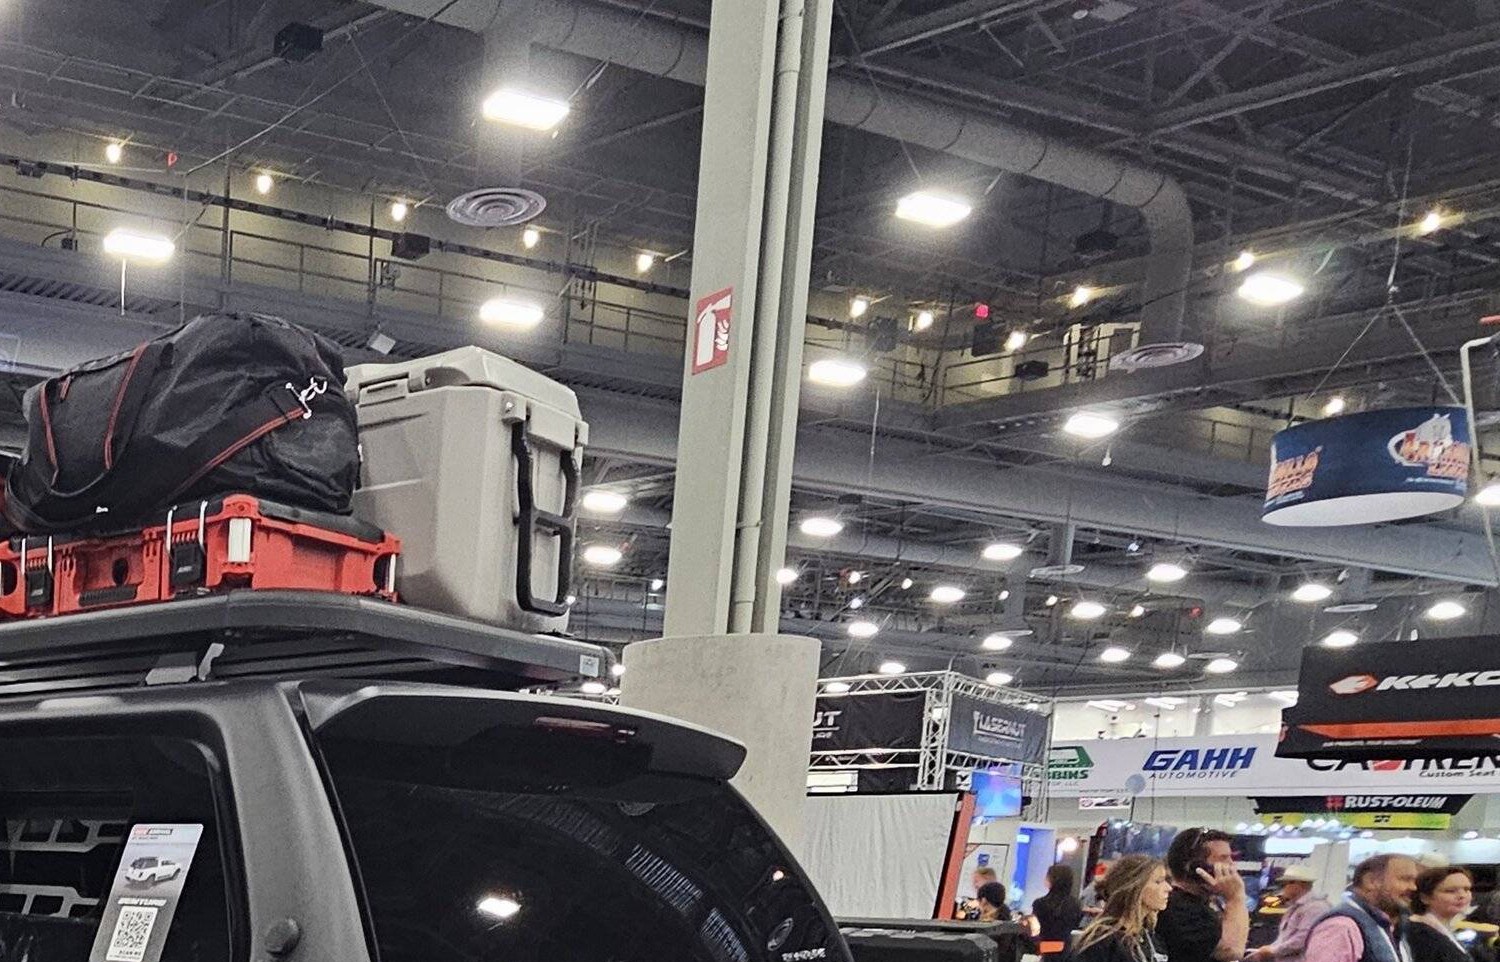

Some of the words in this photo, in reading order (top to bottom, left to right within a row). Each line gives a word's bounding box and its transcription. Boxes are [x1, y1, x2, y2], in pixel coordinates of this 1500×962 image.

[1142, 747, 1257, 770] GAHH
[1149, 770, 1238, 779] AUTOMOTIVE
[1419, 770, 1464, 778] Custom
[1469, 769, 1495, 777] Seat
[1344, 796, 1448, 809] RUST-OLEUM
